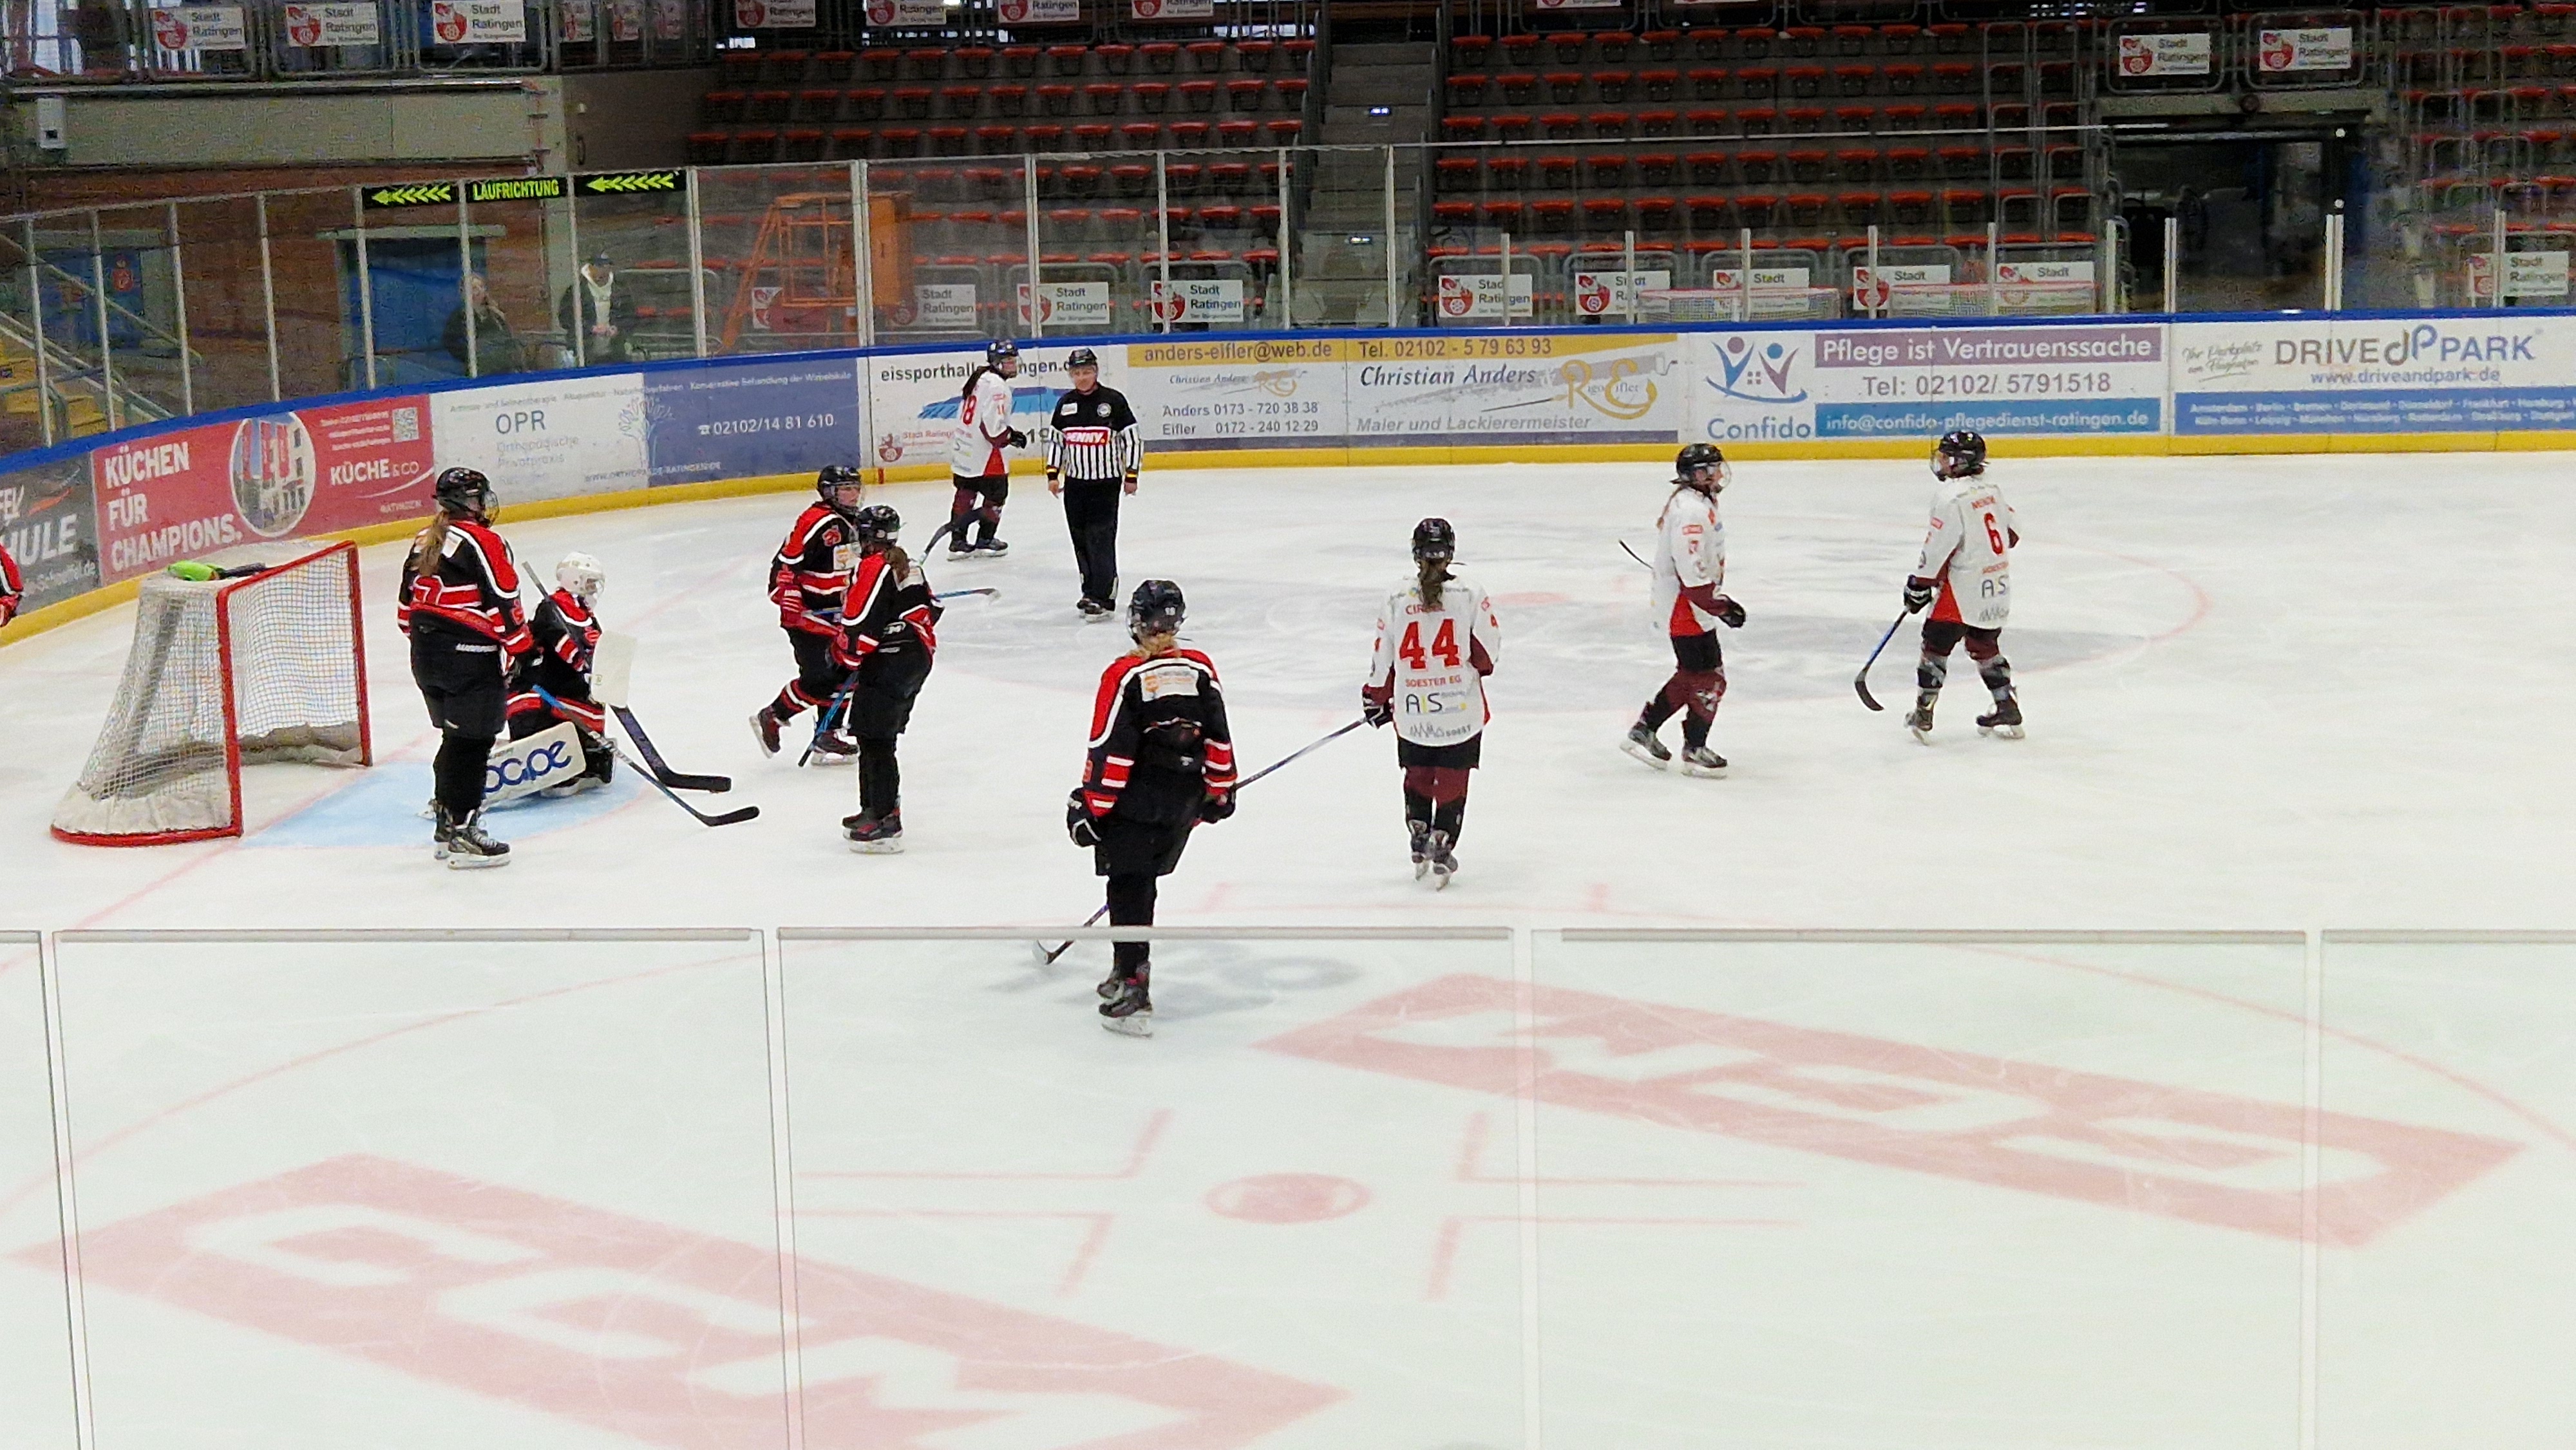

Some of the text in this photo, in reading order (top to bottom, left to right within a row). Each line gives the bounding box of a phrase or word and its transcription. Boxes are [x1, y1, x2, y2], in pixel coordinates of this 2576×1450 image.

[473, 179, 559, 201] LAUFRICHTUNG
[1754, 273, 1785, 284] Stadt
[923, 288, 952, 299] Stadt
[1056, 287, 1086, 297] Stadt
[1189, 284, 1220, 296] Stadt
[1479, 293, 1530, 306] Ratigen
[923, 301, 974, 315] Ratingen
[1057, 301, 1107, 314] Ratingen
[1190, 299, 1241, 310] Ratingen
[1144, 341, 1332, 362] anders-eifler@web.de
[1358, 341, 1388, 358] Tel.
[1394, 339, 1445, 357] 02102
[1463, 339, 1473, 355] 5
[1479, 339, 1499, 355] 79
[1505, 338, 1526, 355] 63
[1531, 338, 1552, 354] 93
[1823, 333, 2152, 366] Pflege ist Vertrauenssache
[2275, 338, 2380, 365] DRIVE
[2440, 335, 2536, 362] PARK
[1360, 363, 1537, 386] Christian Anders
[1862, 372, 2111, 397] Tel: 02102/ 5791518
[2311, 366, 2501, 384] www.driveandpark.de
[1162, 404, 1210, 417] Anders
[1214, 403, 1245, 415] 0173
[1257, 402, 1280, 414] 720
[1284, 402, 1299, 413] 38
[1302, 401, 1318, 413] 38
[496, 410, 546, 435] OPR
[714, 413, 834, 435] 02102/14 81 610
[1162, 422, 1196, 435] Eifler
[1215, 422, 1245, 434] 0172
[1258, 421, 1280, 433] 240
[1285, 420, 1299, 433] 12
[1303, 420, 1318, 431] 29
[1356, 415, 1592, 432] Maler und Lackierermeister
[1707, 416, 1812, 440] Confido
[1826, 410, 2150, 433] info@confido-pflegedienst-ratingen.de
[105, 441, 191, 489] KÜCHEN
[330, 458, 390, 487] KÜCHE
[106, 487, 149, 531] FÜR
[111, 513, 243, 572] CHAMPIONS.
[1984, 512, 2004, 556] 6
[1399, 618, 1461, 670] 44
